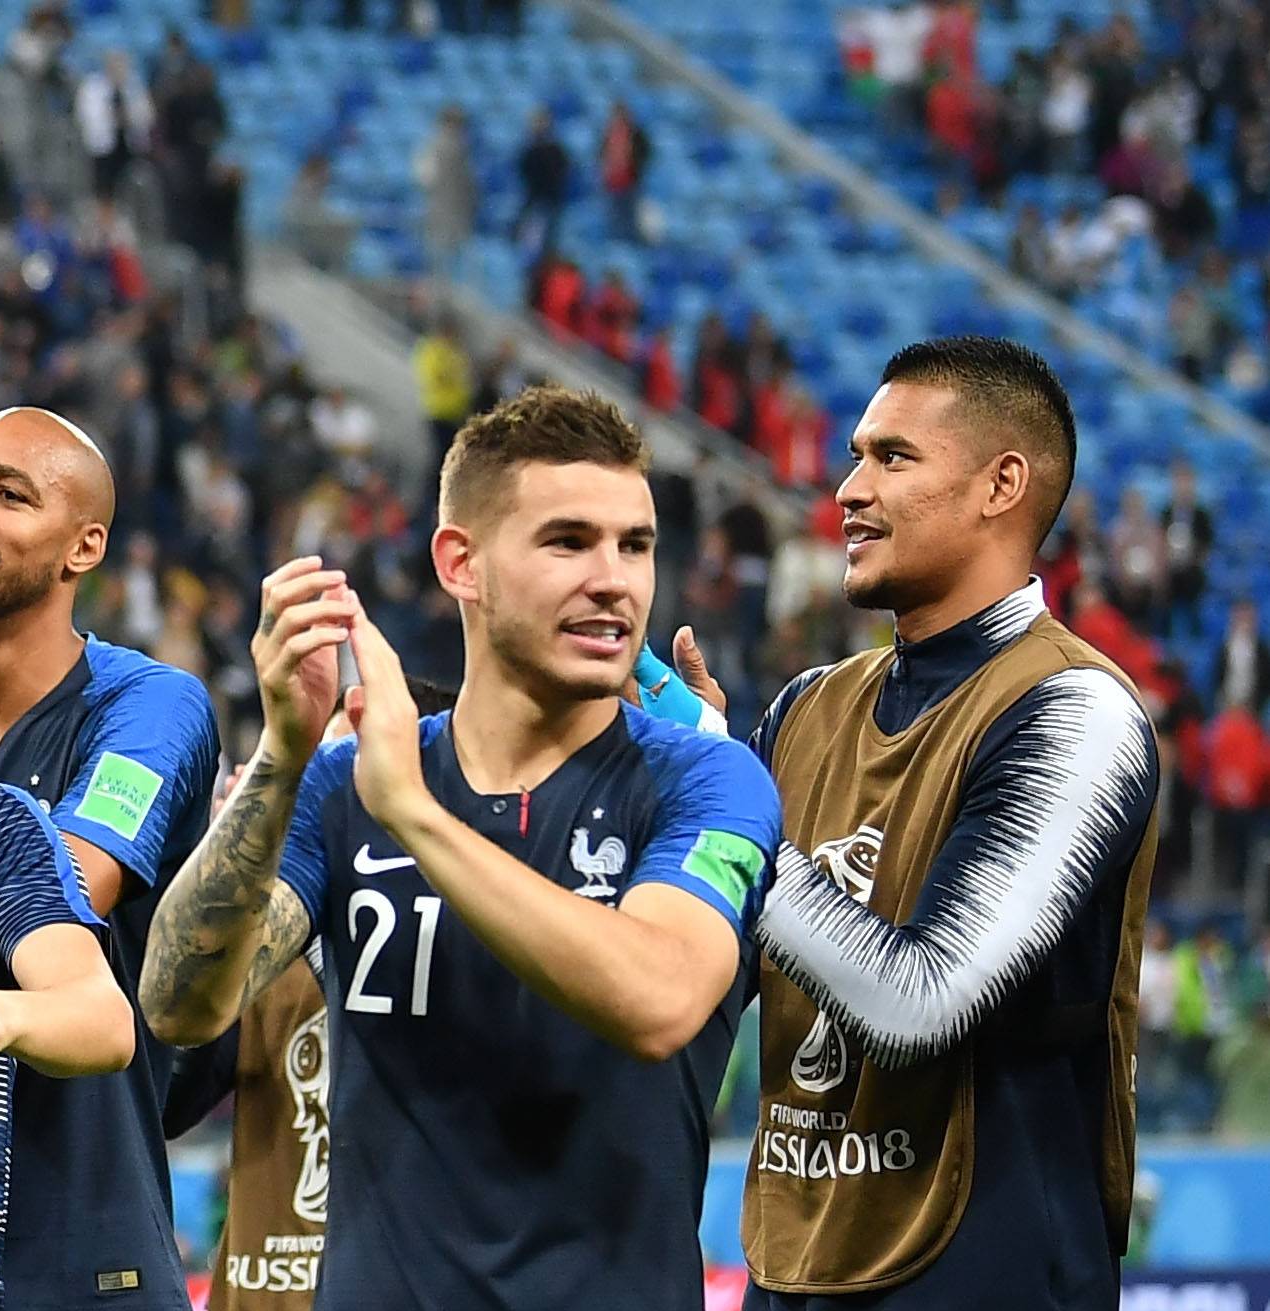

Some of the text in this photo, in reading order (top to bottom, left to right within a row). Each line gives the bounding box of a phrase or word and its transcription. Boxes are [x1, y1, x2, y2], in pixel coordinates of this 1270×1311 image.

[345, 888, 442, 1016] 21
[757, 1128, 917, 1180] USSIA 018
[226, 1253, 319, 1293] RUSSI
